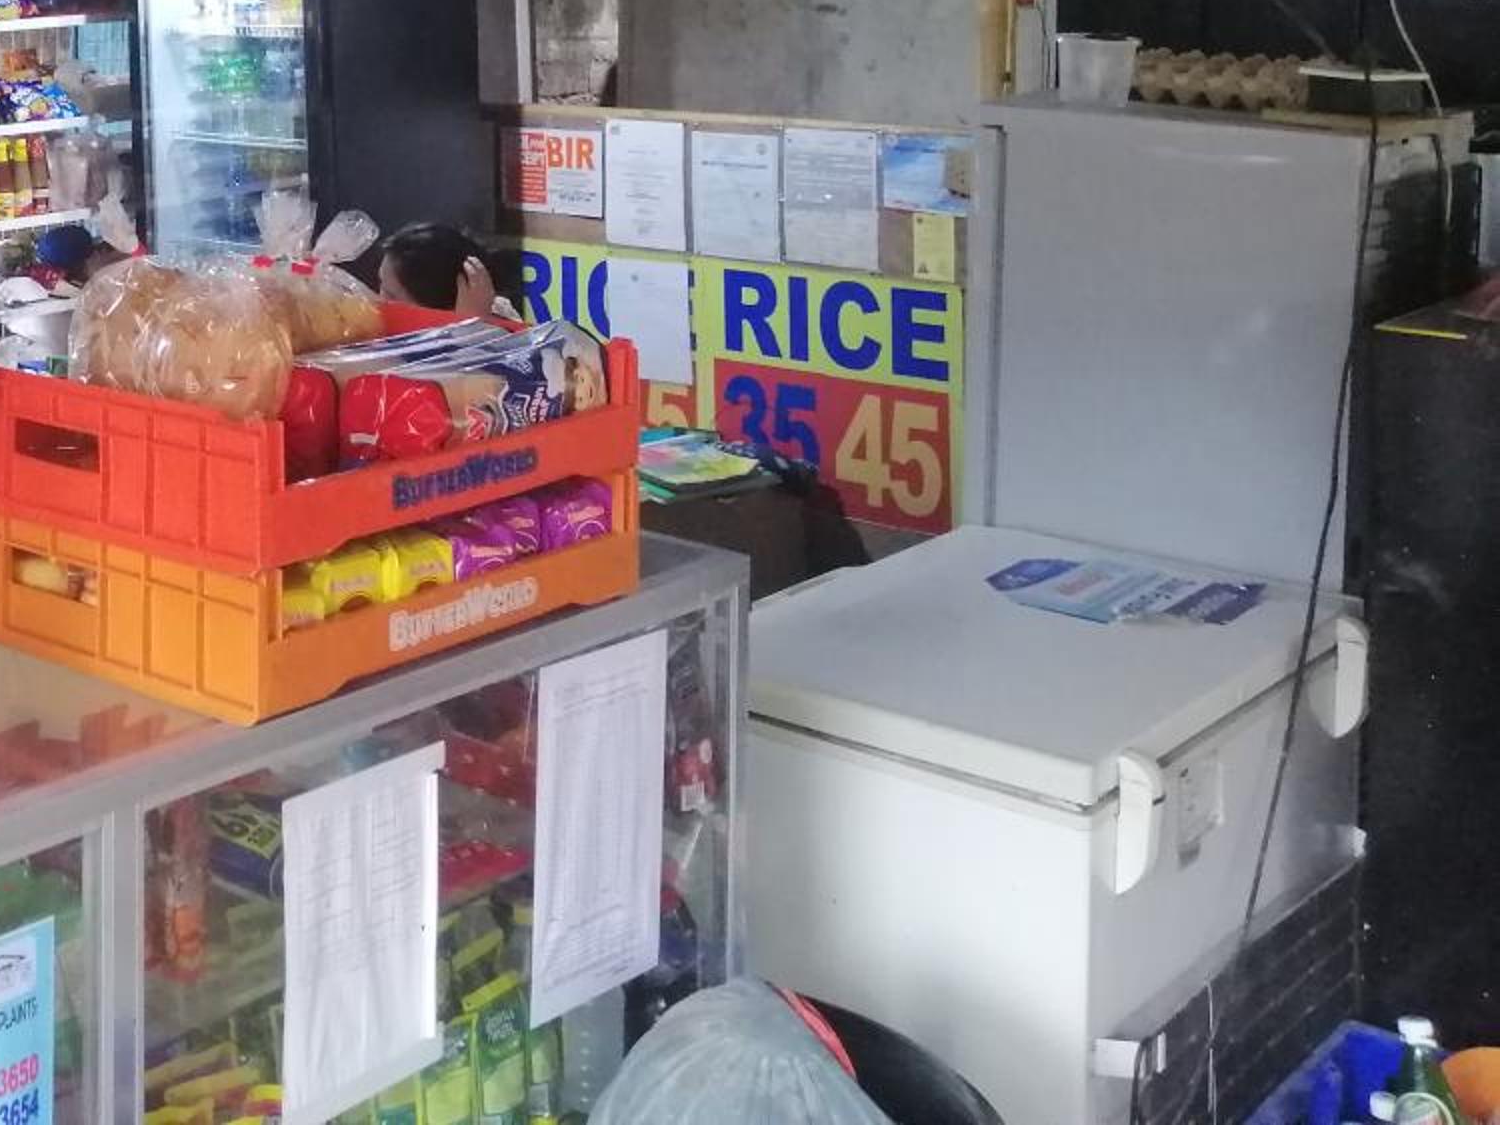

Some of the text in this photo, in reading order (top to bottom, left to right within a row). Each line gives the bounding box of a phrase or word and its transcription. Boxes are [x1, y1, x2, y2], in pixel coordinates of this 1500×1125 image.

[547, 136, 596, 170] BIR
[723, 268, 950, 382] RICE
[724, 374, 943, 518] 35 45
